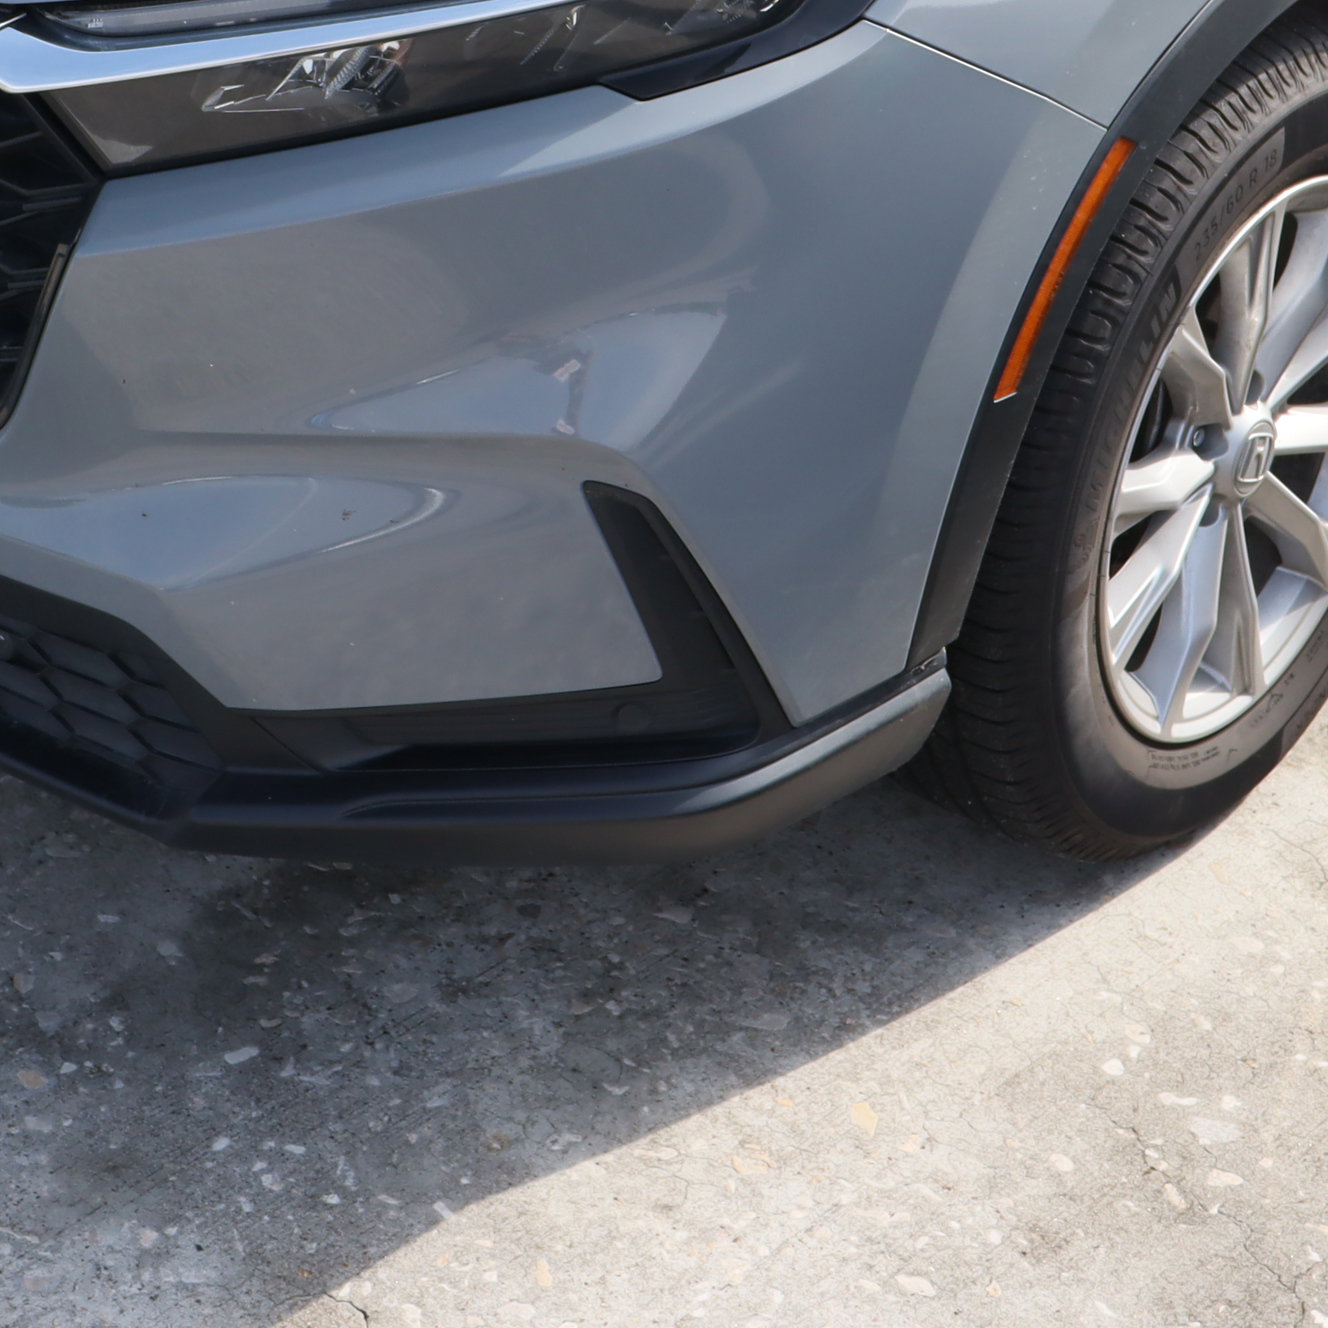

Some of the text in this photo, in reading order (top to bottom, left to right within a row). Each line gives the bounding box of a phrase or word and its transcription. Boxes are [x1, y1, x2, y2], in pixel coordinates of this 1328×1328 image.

[1193, 148, 1278, 263] 235/60 R 18
